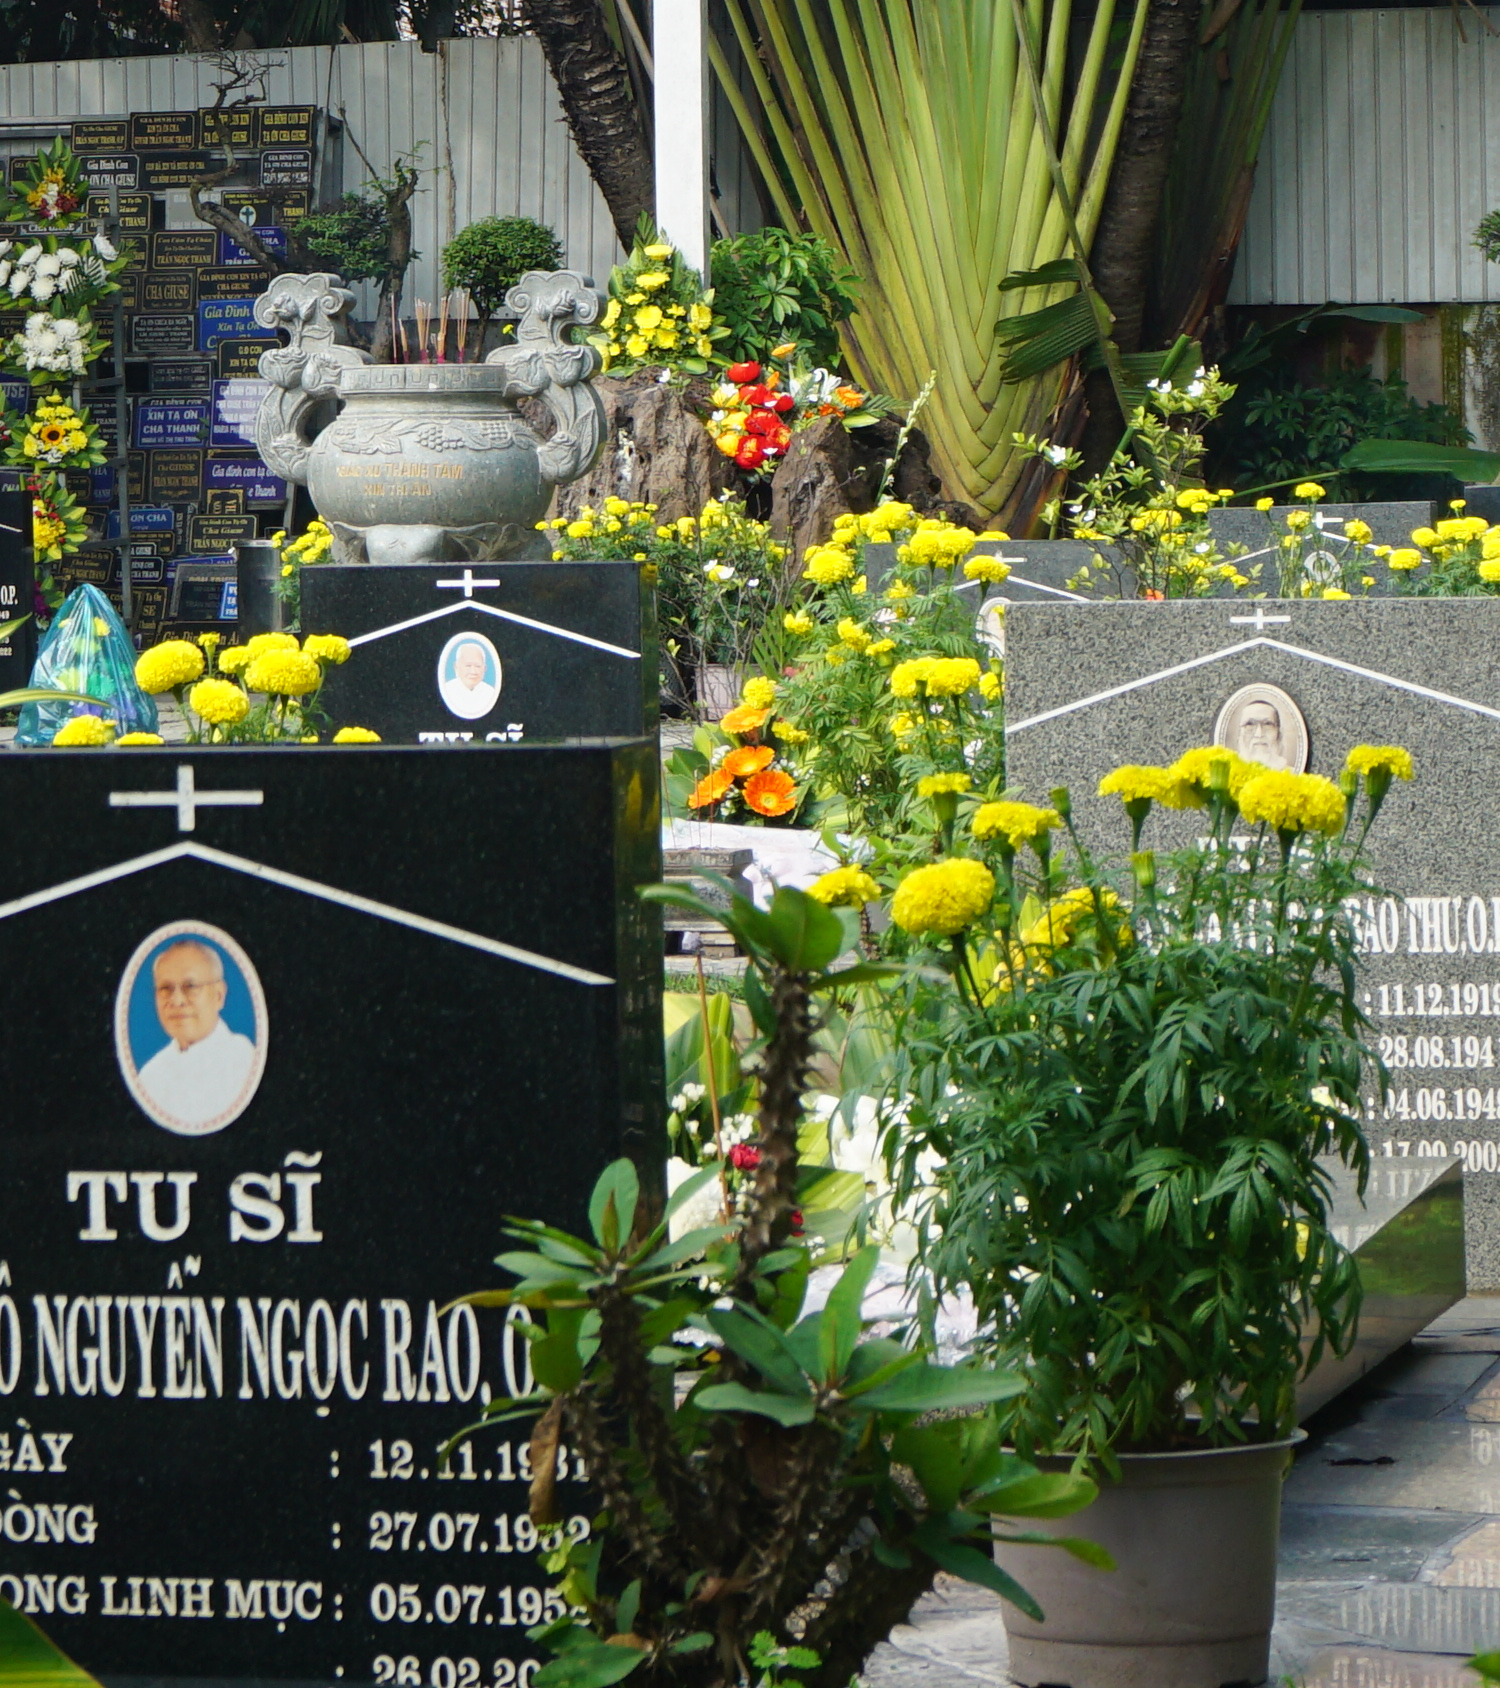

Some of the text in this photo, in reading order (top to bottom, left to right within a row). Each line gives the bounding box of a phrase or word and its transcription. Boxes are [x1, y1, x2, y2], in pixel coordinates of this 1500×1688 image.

[145, 284, 189, 300] CHA GIUSE
[205, 305, 250, 319] Gia Đình
[217, 322, 233, 332] Xin
[147, 411, 166, 421] XIN
[168, 411, 182, 423] TẠ
[143, 424, 199, 433] CHA THANH
[212, 465, 225, 477] Gia
[147, 513, 167, 522] CHA
[67, 1150, 326, 1244] TU SĨ
[32, 1255, 226, 1399] NGUYỄN
[237, 1297, 370, 1418] NGỌC
[380, 1298, 493, 1422] RAO,
[100, 1576, 215, 1619] LINH
[225, 1578, 324, 1634] MỤC
[372, 1654, 545, 1688] 26.02.20
